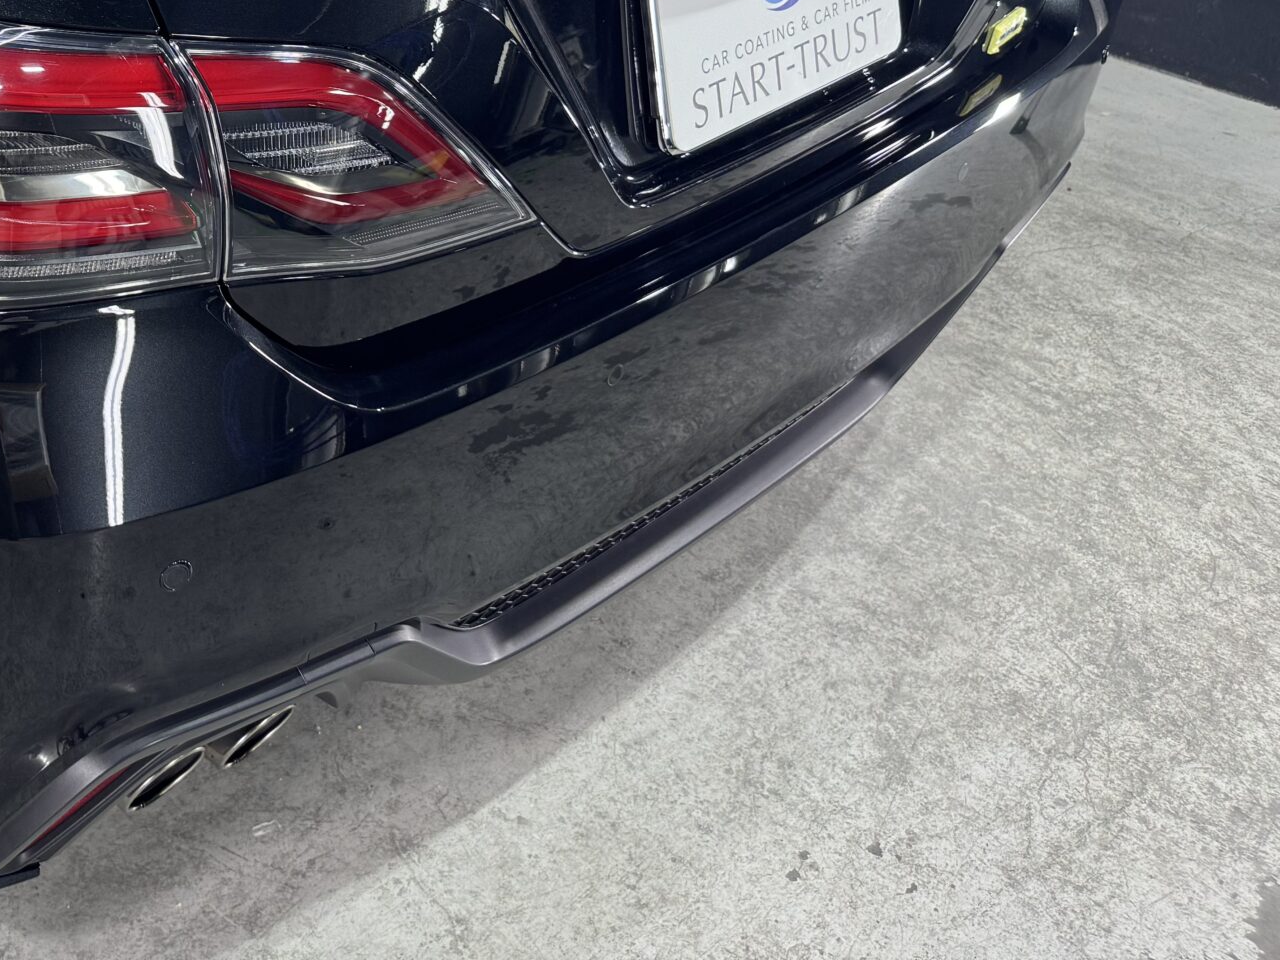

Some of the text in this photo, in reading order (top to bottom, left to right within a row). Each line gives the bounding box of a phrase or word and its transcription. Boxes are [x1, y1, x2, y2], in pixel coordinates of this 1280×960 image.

[692, 8, 882, 129] START-TRUST
[701, 49, 730, 74] CAR
[734, 21, 796, 60] COATING
[801, 16, 809, 31] &
[814, 6, 839, 25] CAR
